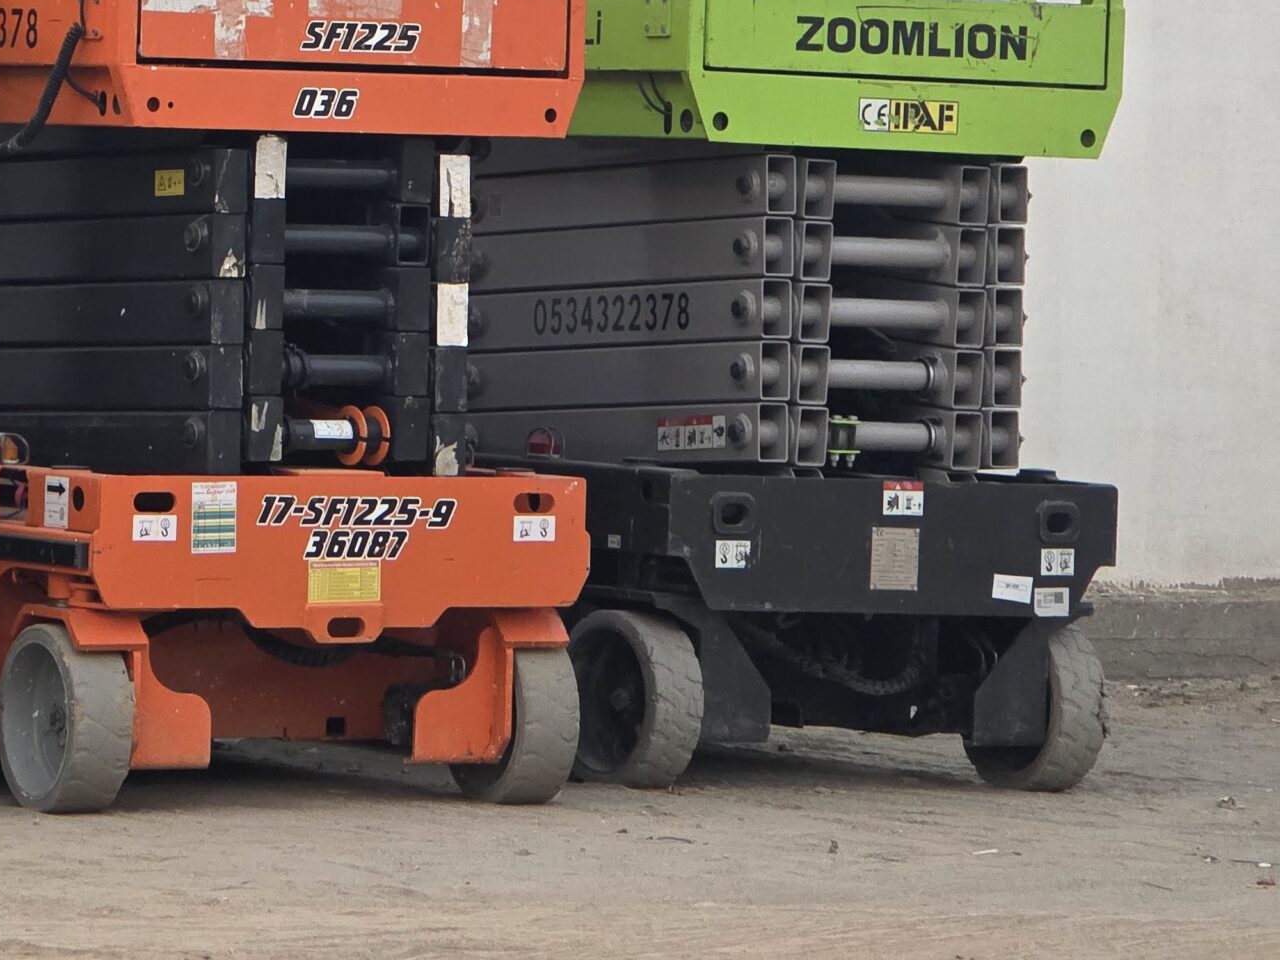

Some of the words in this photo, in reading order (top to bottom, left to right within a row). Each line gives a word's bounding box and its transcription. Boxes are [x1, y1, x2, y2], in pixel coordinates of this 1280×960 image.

[300, 21, 421, 53] SF1225
[795, 16, 1028, 61] ZOOMLION
[293, 87, 360, 119] 036
[894, 100, 954, 131] IPAF
[533, 292, 690, 336] 0534322378
[257, 495, 456, 529] 17-SF1225-9
[303, 529, 409, 560] 36087
